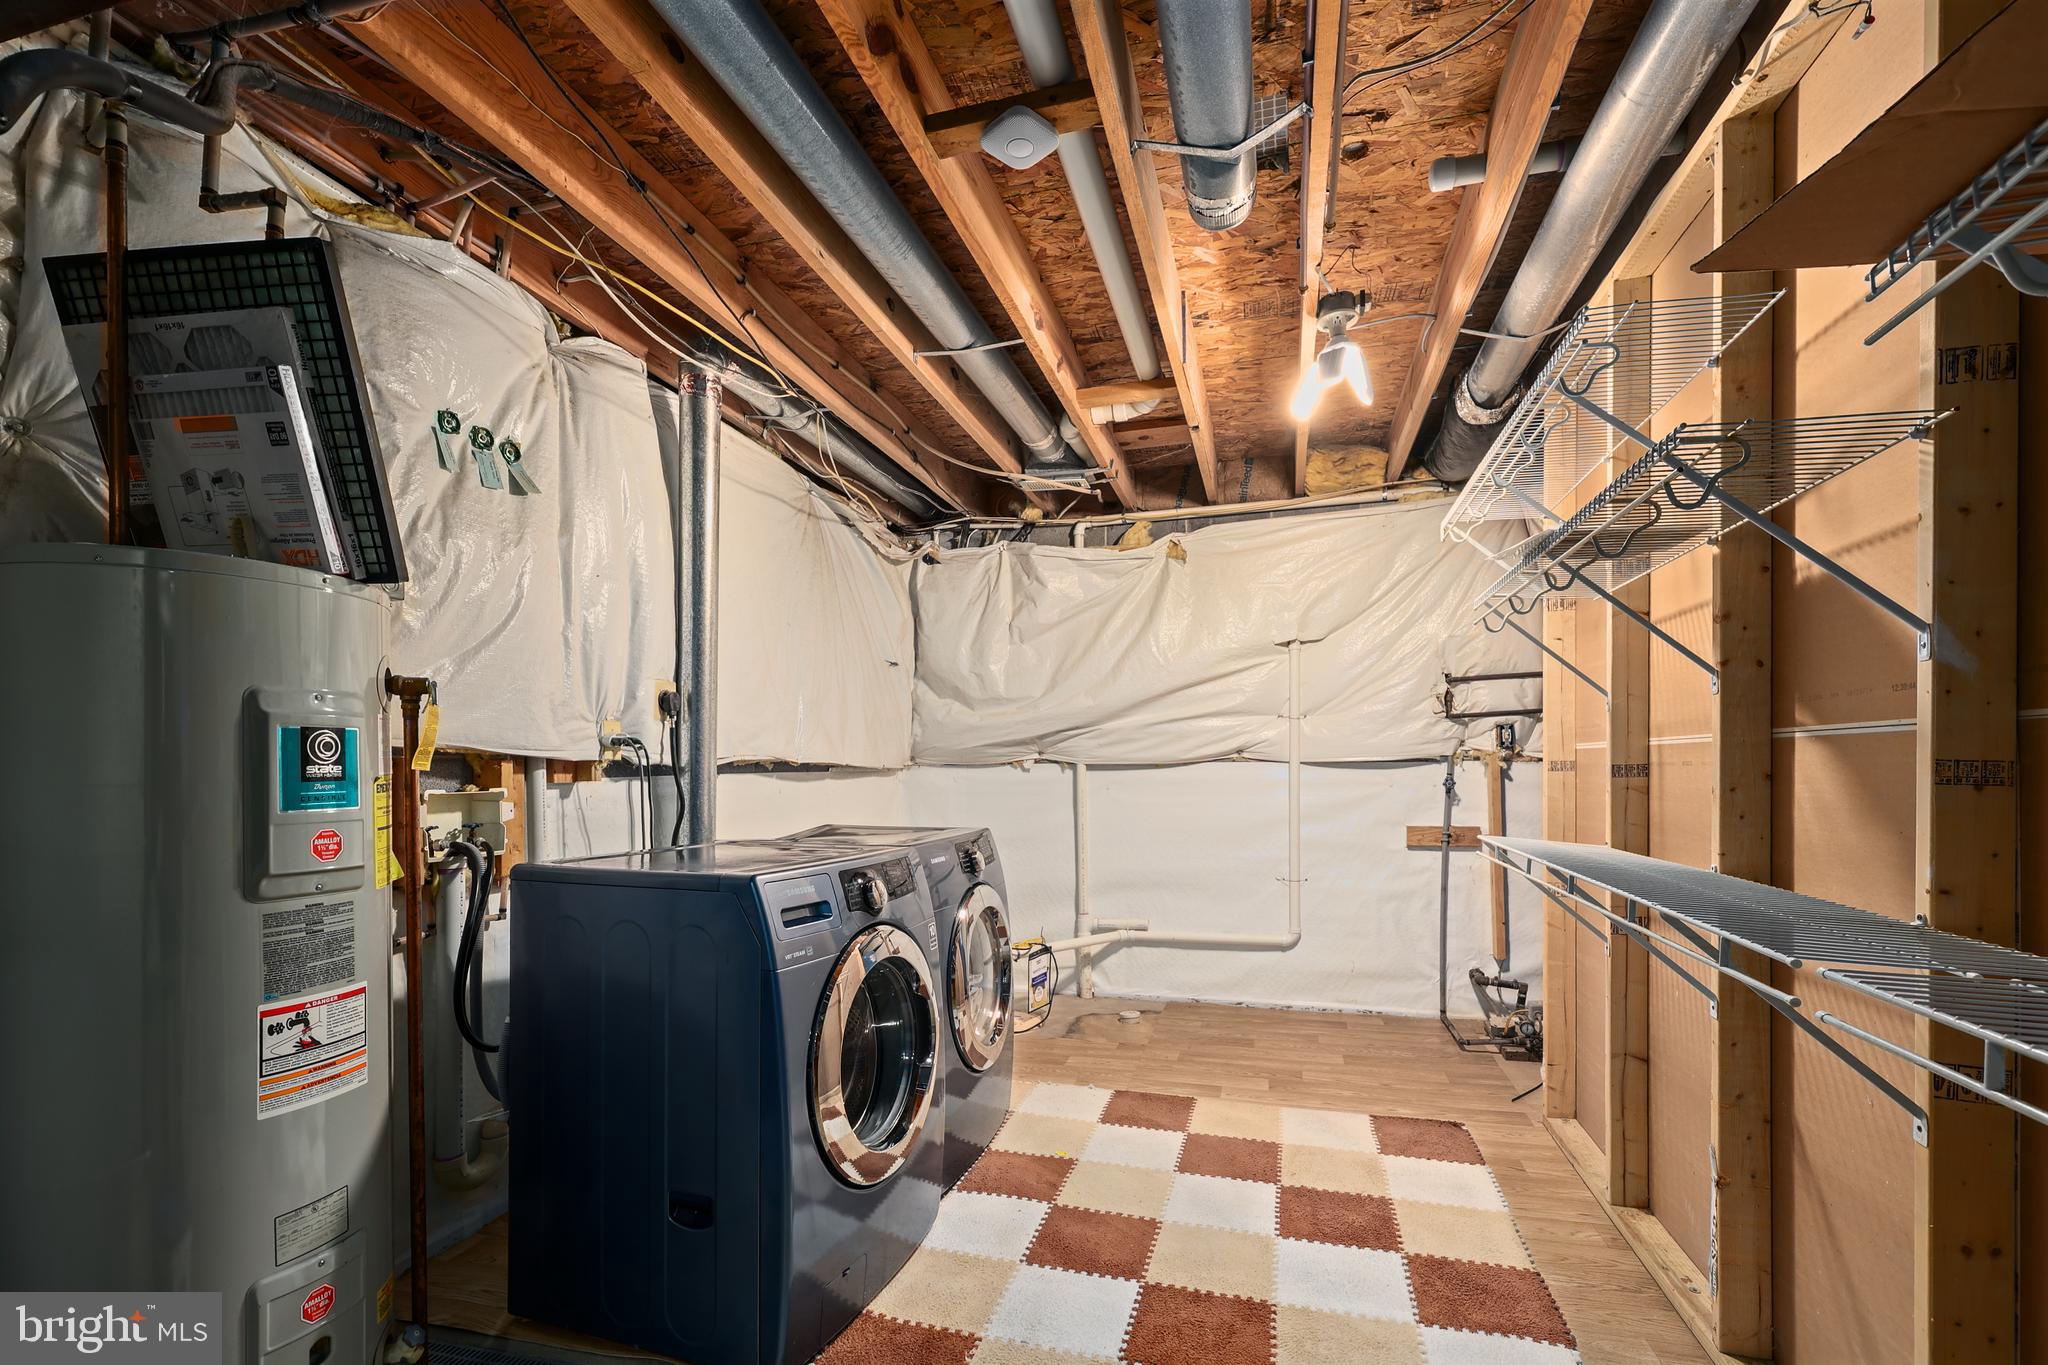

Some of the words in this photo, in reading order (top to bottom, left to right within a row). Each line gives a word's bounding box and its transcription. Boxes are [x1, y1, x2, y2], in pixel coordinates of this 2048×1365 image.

[306, 764, 342, 774] state
[312, 995, 339, 1006] DANGER
[311, 1061, 337, 1072] WARNING
